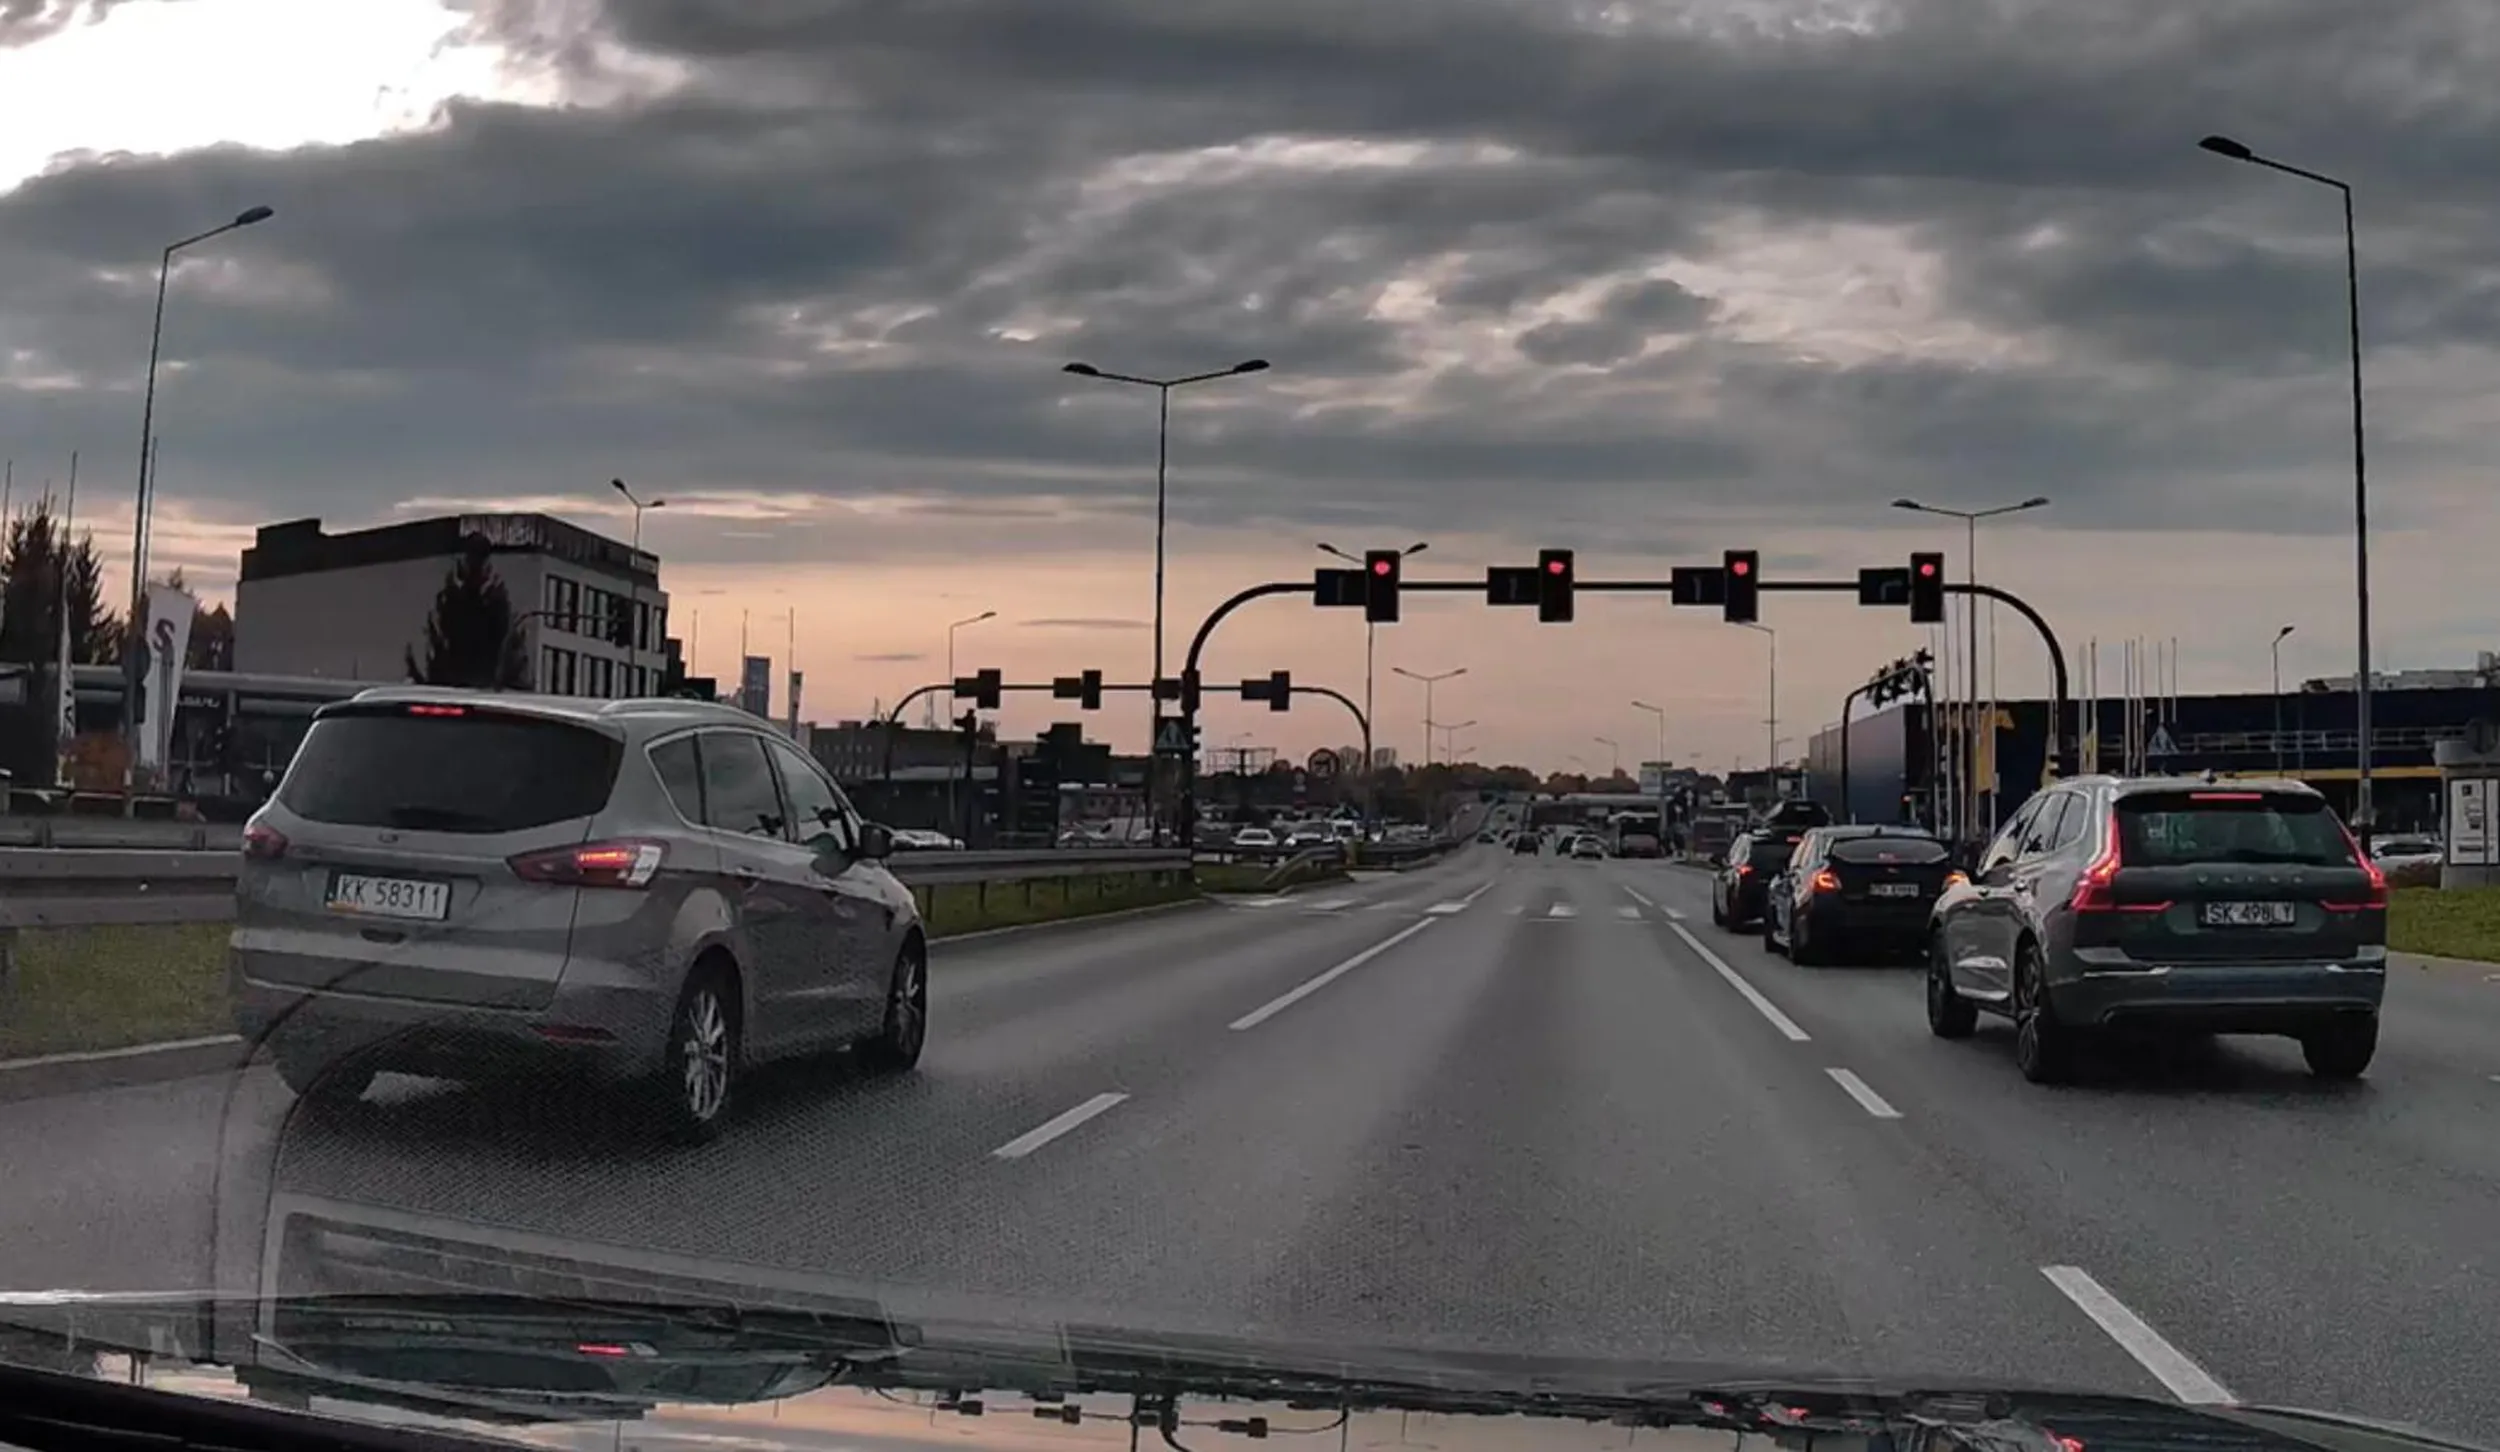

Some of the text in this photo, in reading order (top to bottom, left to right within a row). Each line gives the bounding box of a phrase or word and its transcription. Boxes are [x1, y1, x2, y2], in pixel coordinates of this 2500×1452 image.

[341, 879, 440, 912] KK 58311
[2210, 903, 2235, 923] SK
